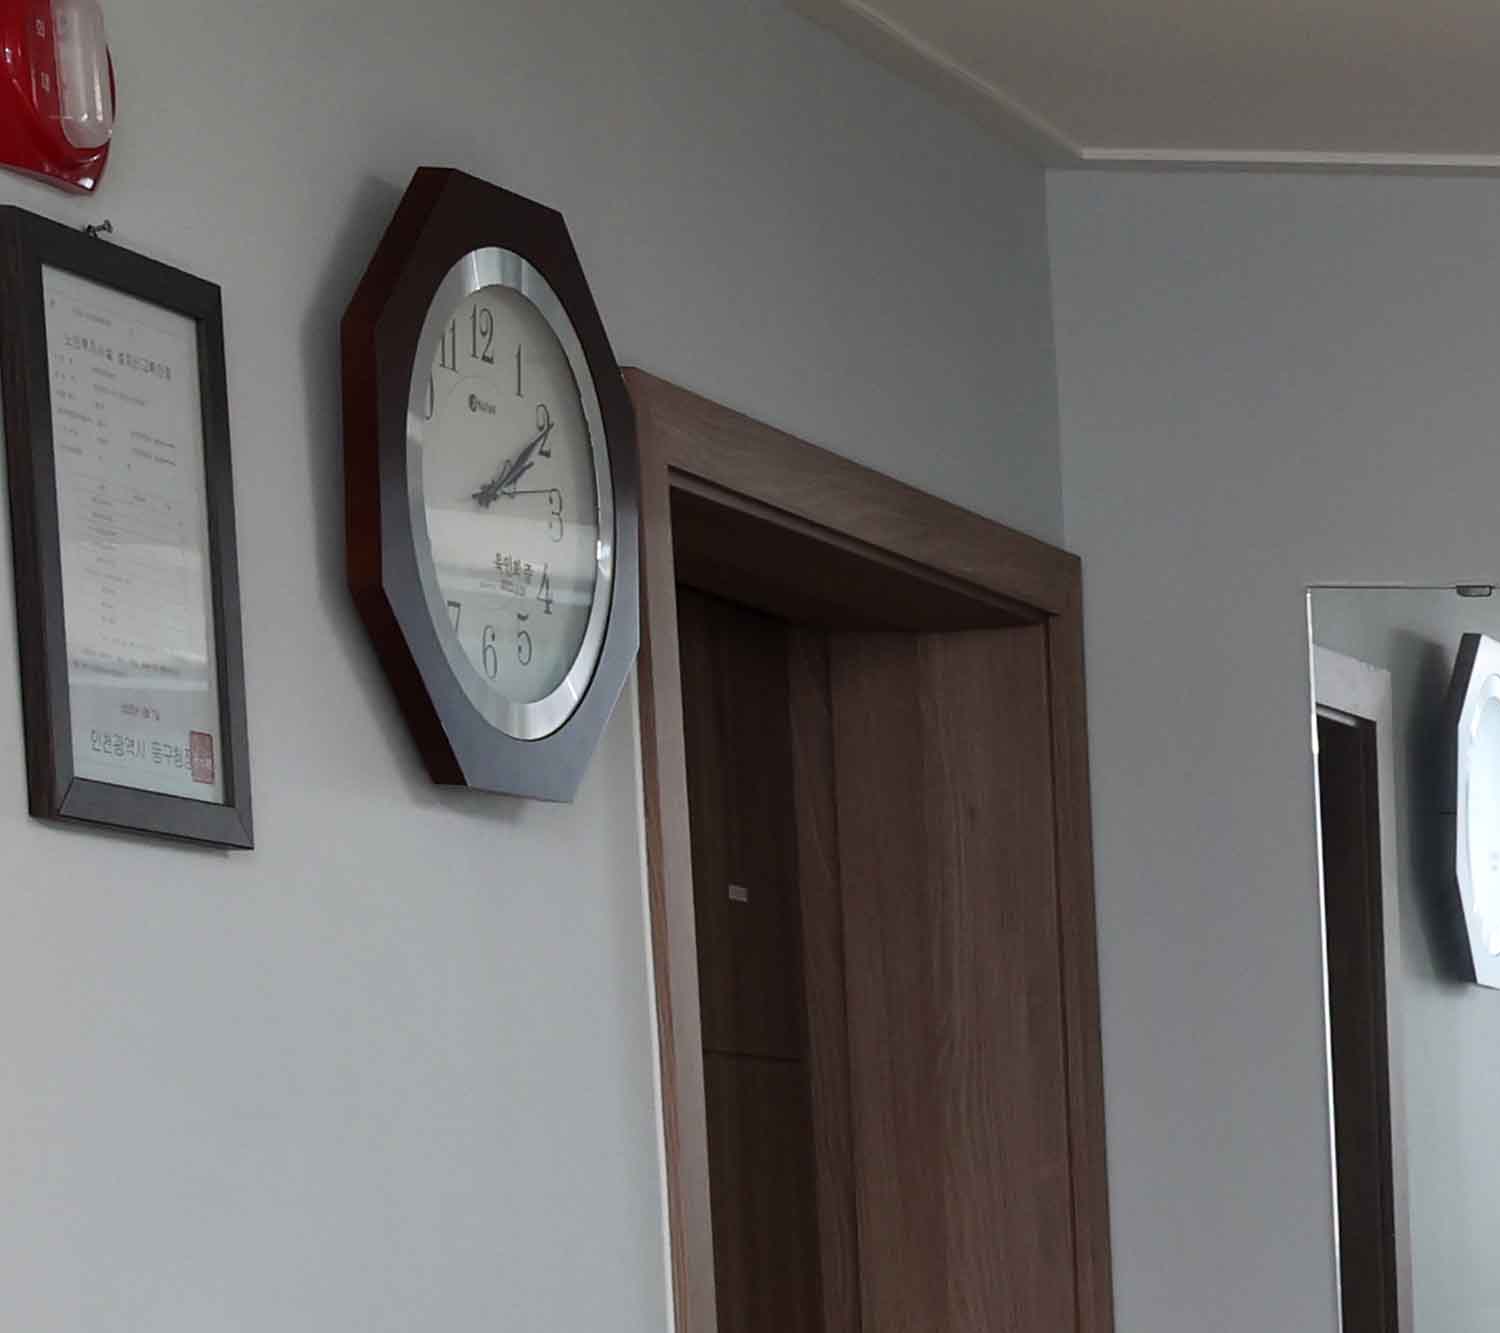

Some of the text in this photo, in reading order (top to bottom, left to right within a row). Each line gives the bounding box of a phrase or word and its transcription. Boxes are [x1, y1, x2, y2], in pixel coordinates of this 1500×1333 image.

[471, 304, 495, 364] 12
[515, 344, 524, 397] 1
[536, 404, 552, 458] 2
[549, 488, 563, 542] 3
[537, 563, 552, 615] 4
[483, 625, 497, 679] 6
[516, 612, 532, 666] 5
